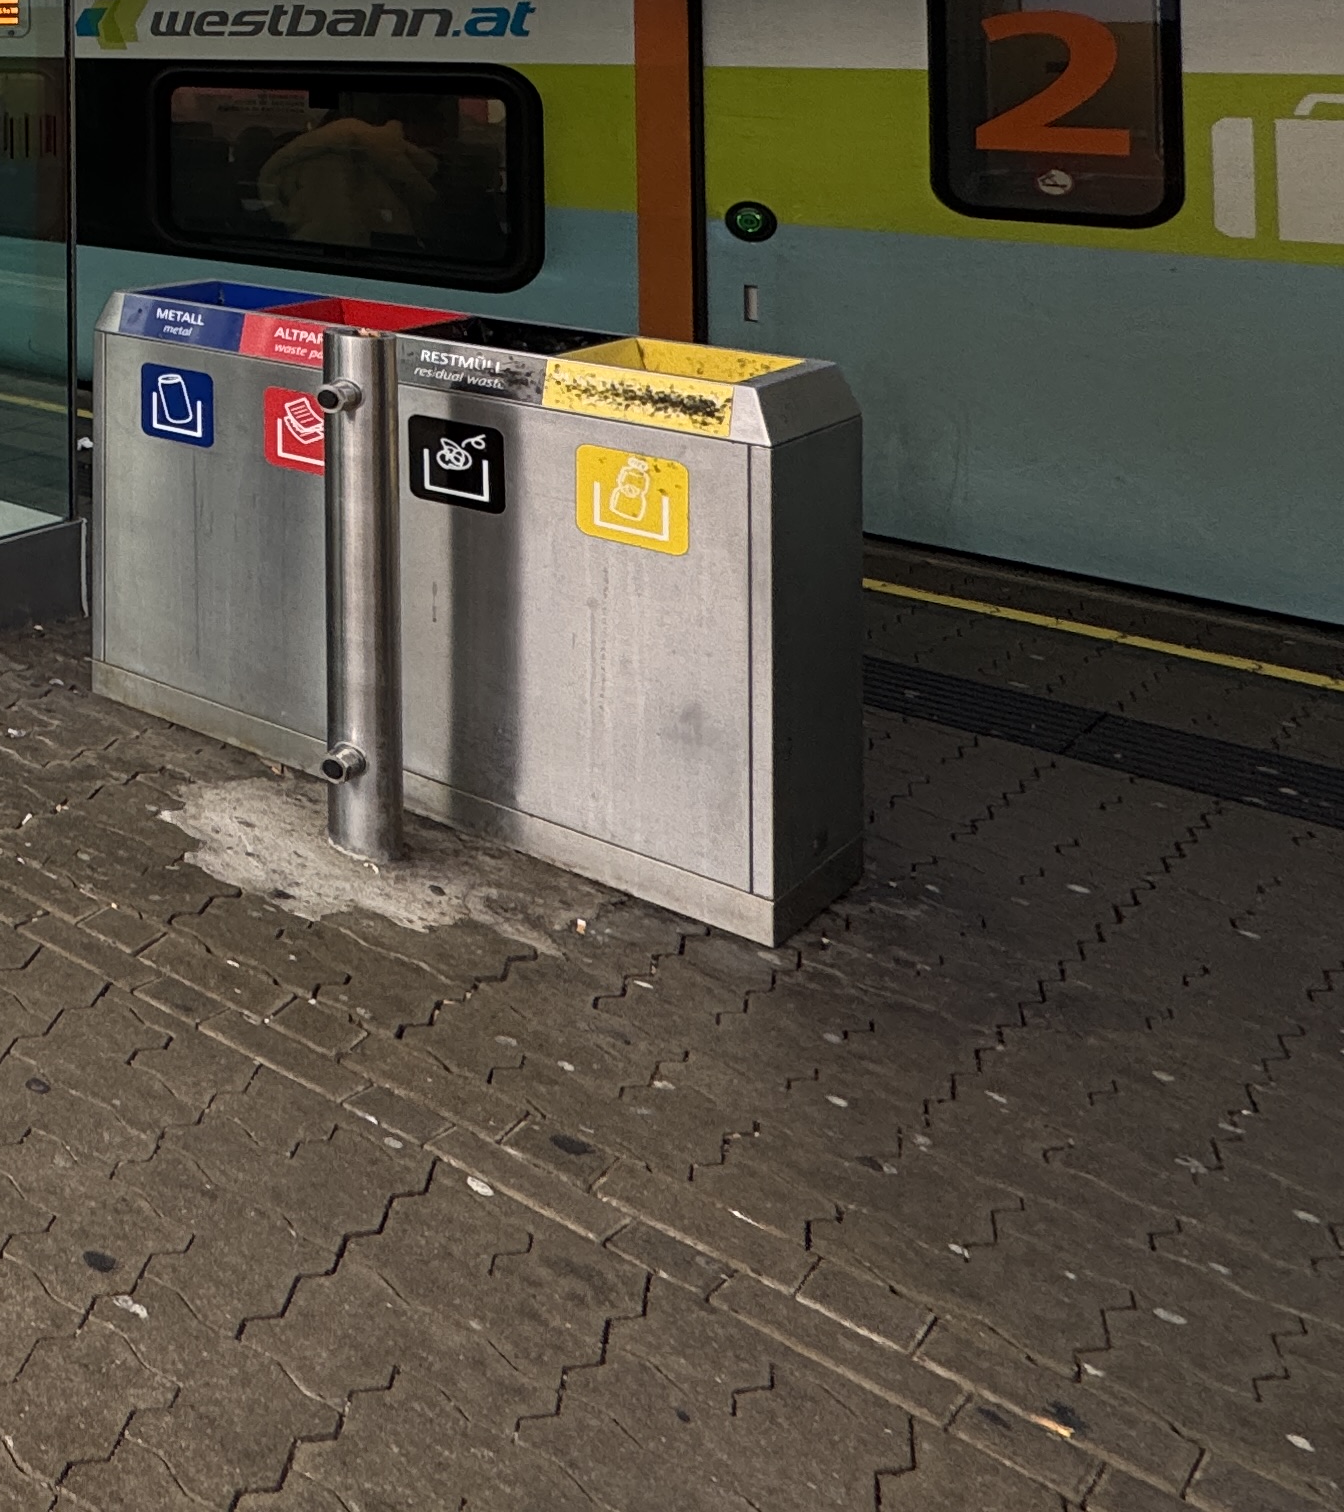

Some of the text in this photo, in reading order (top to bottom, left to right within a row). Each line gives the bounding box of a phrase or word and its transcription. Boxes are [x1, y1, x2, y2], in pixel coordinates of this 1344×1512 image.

[150, 1, 537, 38] westbahn.at
[975, 9, 1131, 156] 2
[156, 307, 205, 326] METALL
[162, 323, 193, 337] metal
[274, 343, 307, 357] waste
[413, 366, 464, 383] residual
